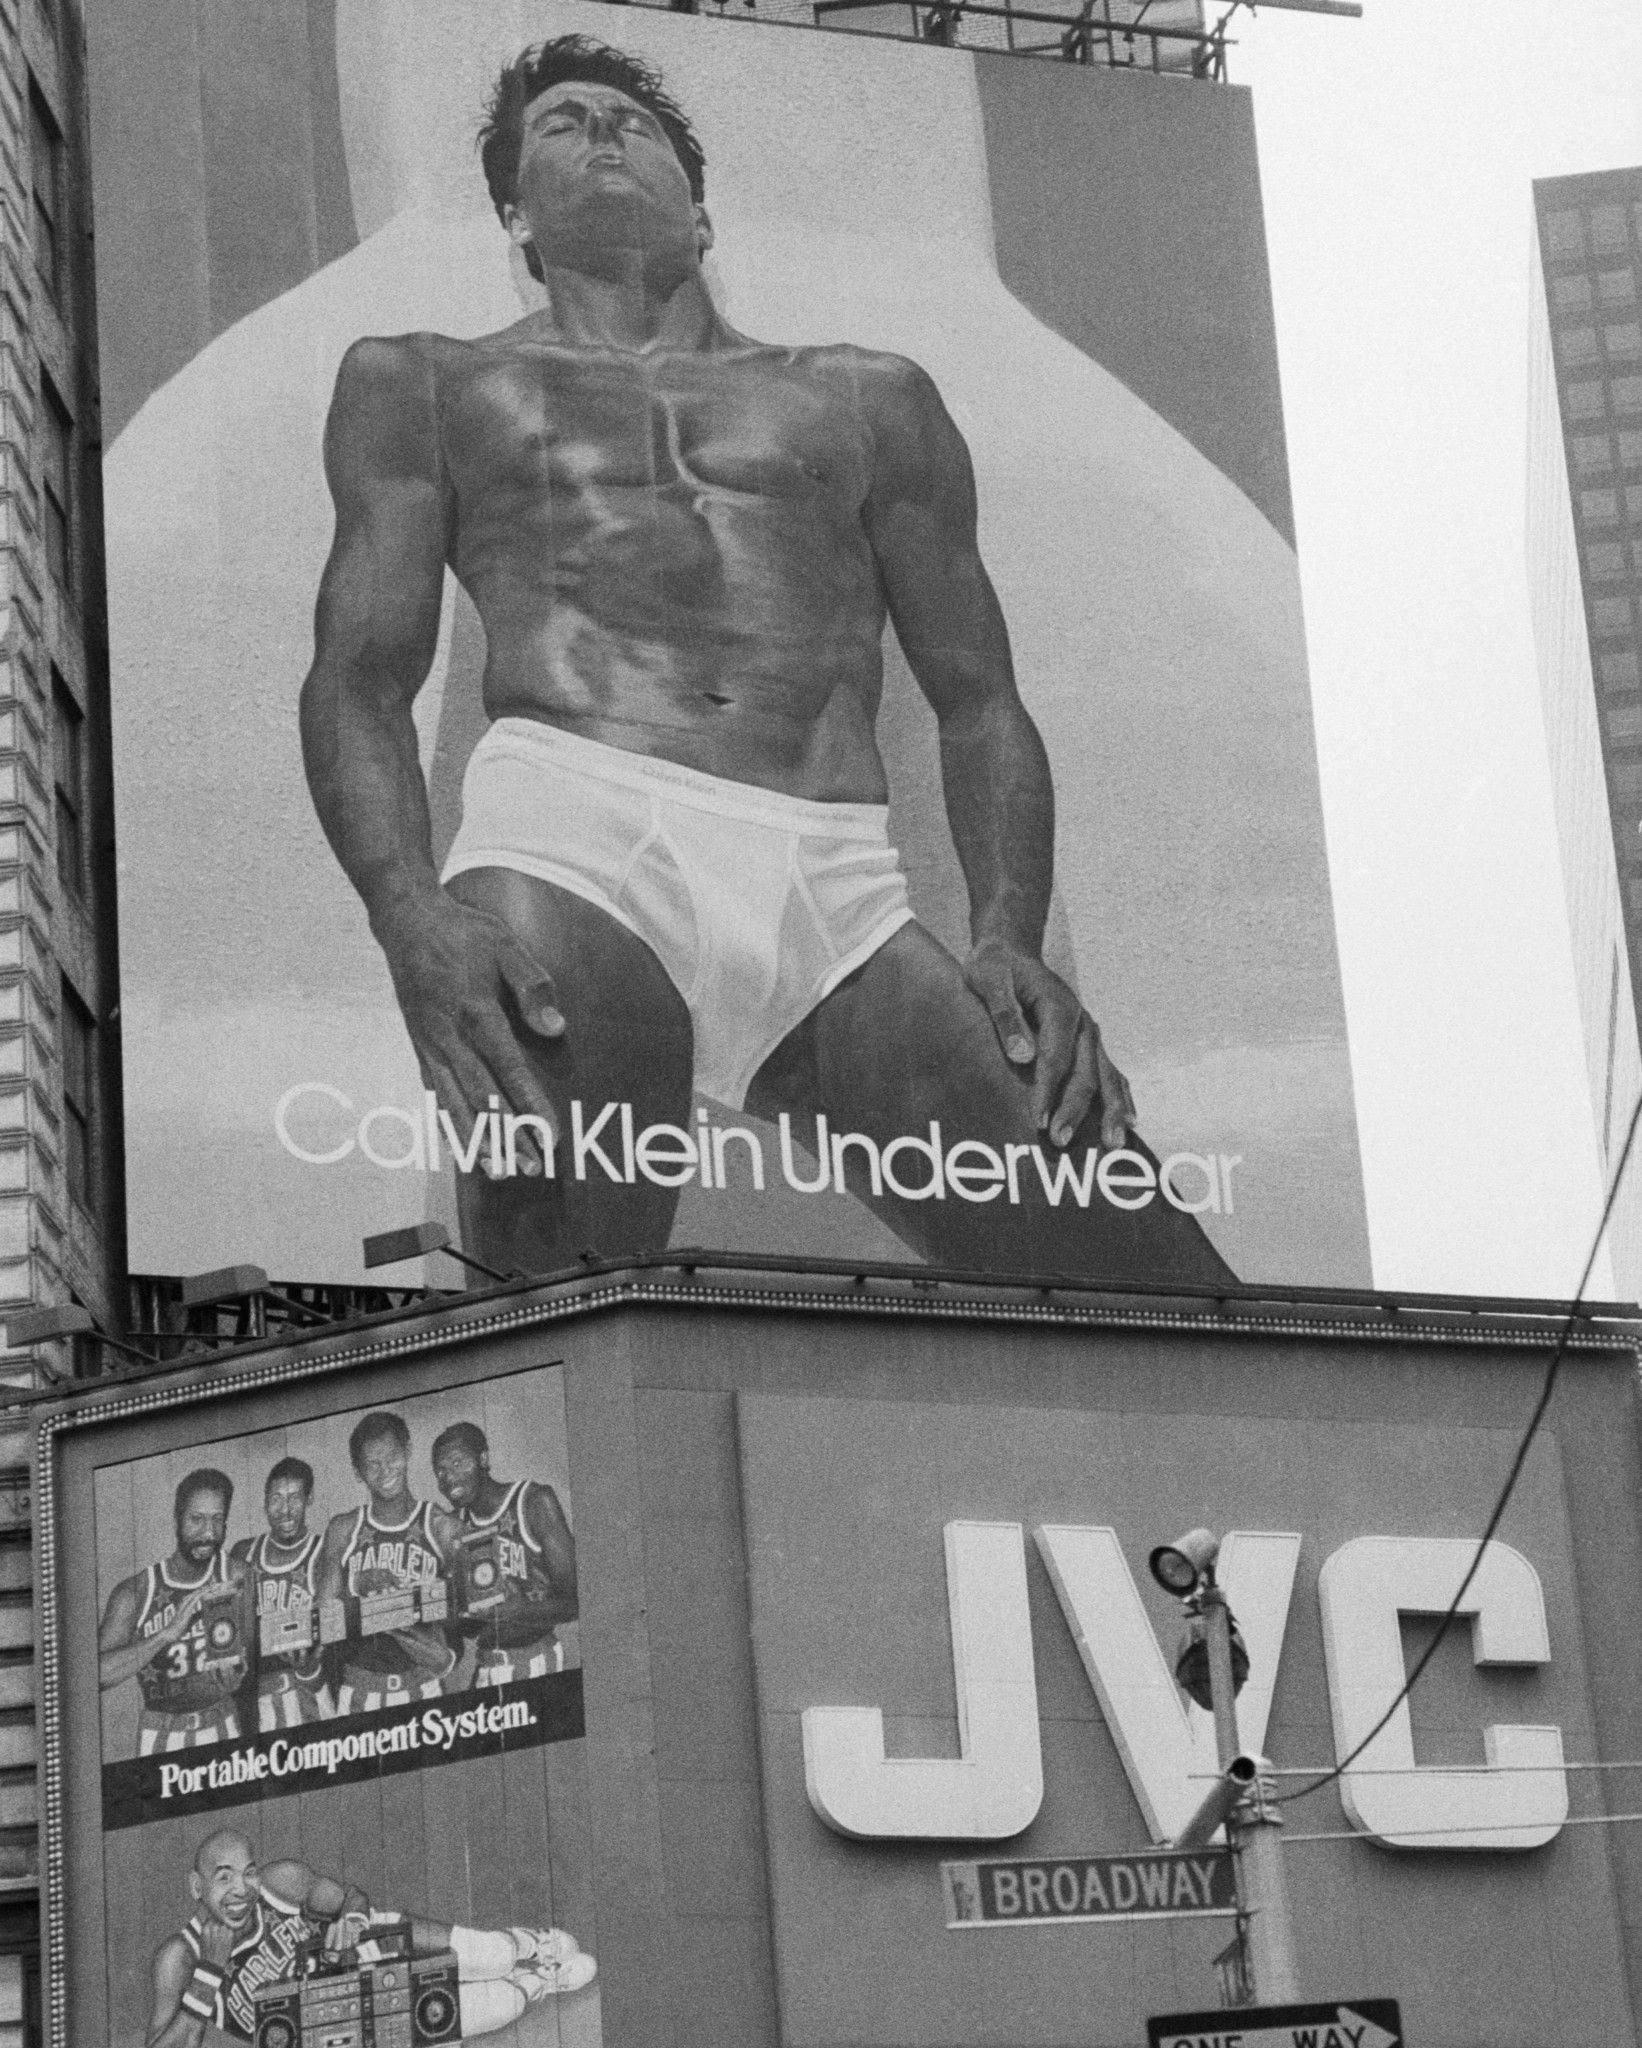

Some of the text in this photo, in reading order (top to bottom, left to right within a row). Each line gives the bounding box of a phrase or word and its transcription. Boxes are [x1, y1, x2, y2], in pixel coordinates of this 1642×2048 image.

[274, 1081, 1243, 1216] Calvin Klein Underwear
[802, 1519, 1572, 1849] JVC
[159, 1699, 538, 1798] Portable Component System.
[992, 1859, 1218, 1915] BROADWAY
